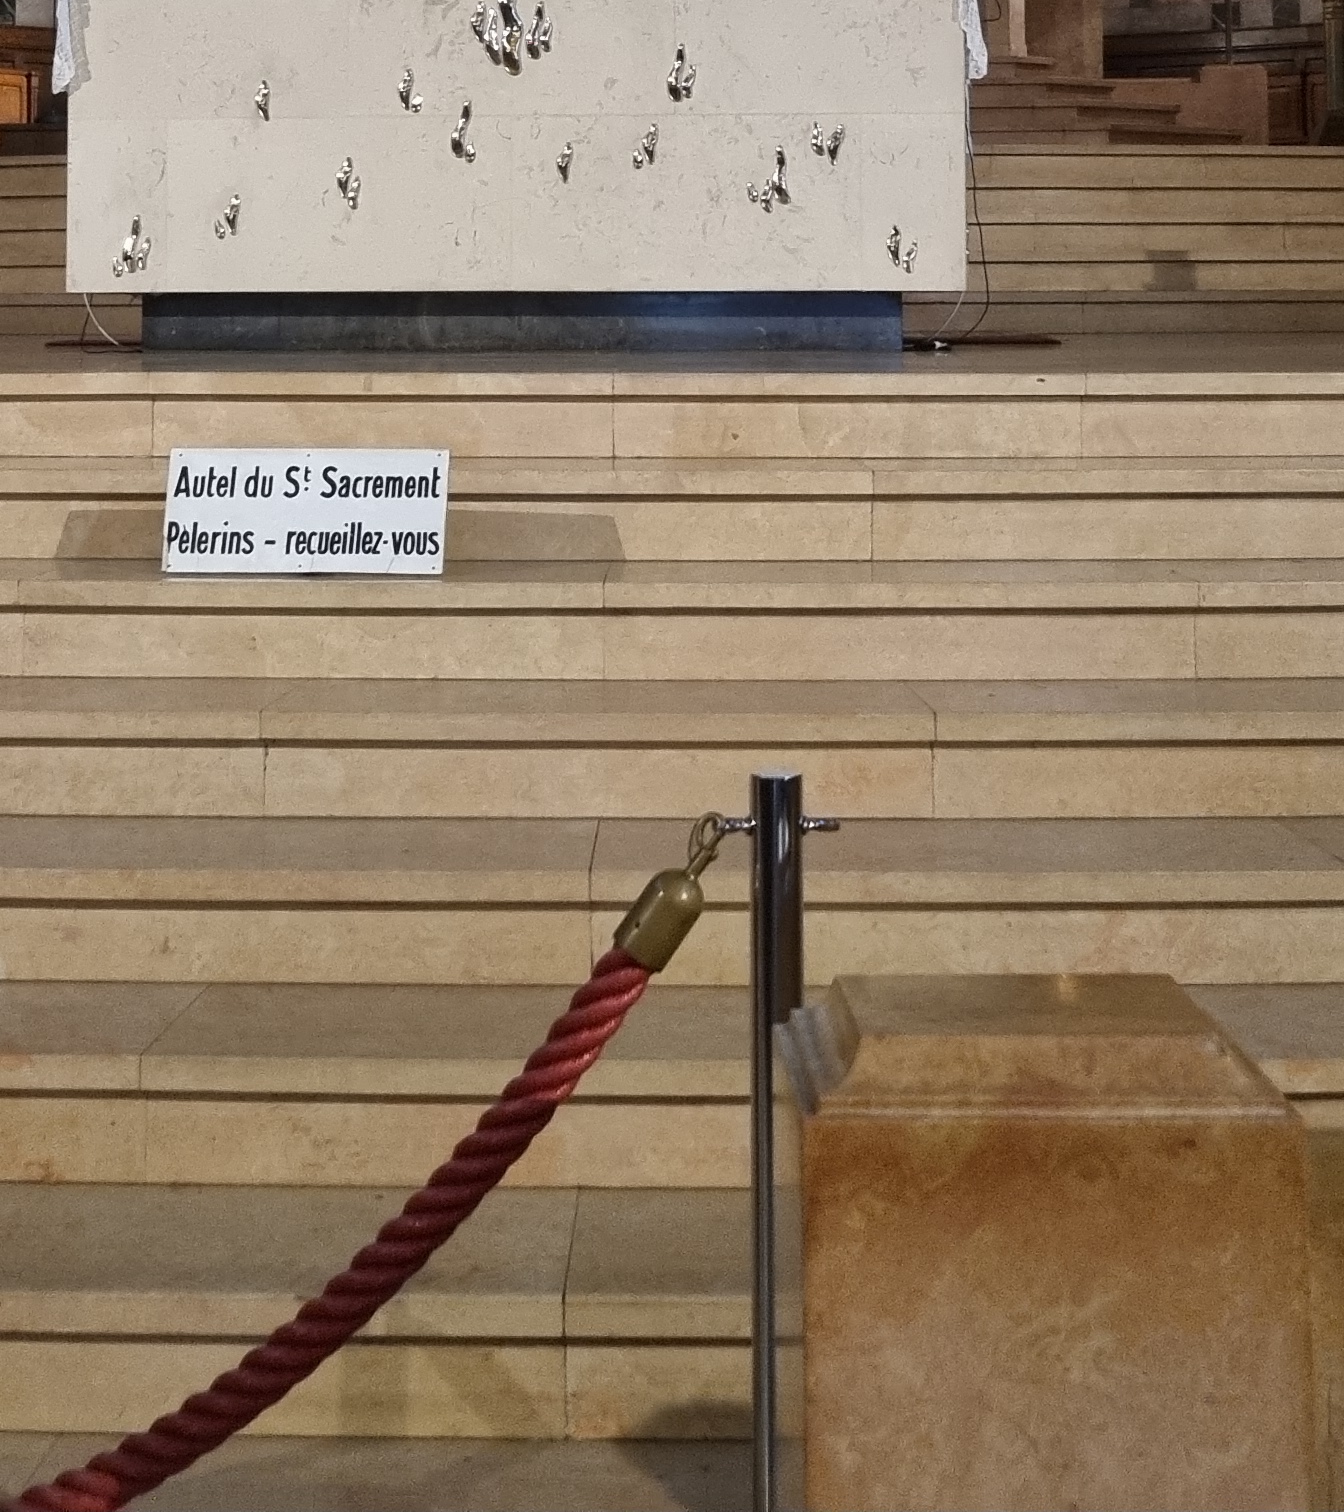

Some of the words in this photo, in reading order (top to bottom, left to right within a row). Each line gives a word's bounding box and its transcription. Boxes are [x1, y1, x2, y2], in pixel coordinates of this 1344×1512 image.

[173, 465, 237, 498] Autel
[244, 466, 273, 498] du
[320, 466, 441, 498] Sacrement
[285, 522, 440, 555] recueillez-vous
